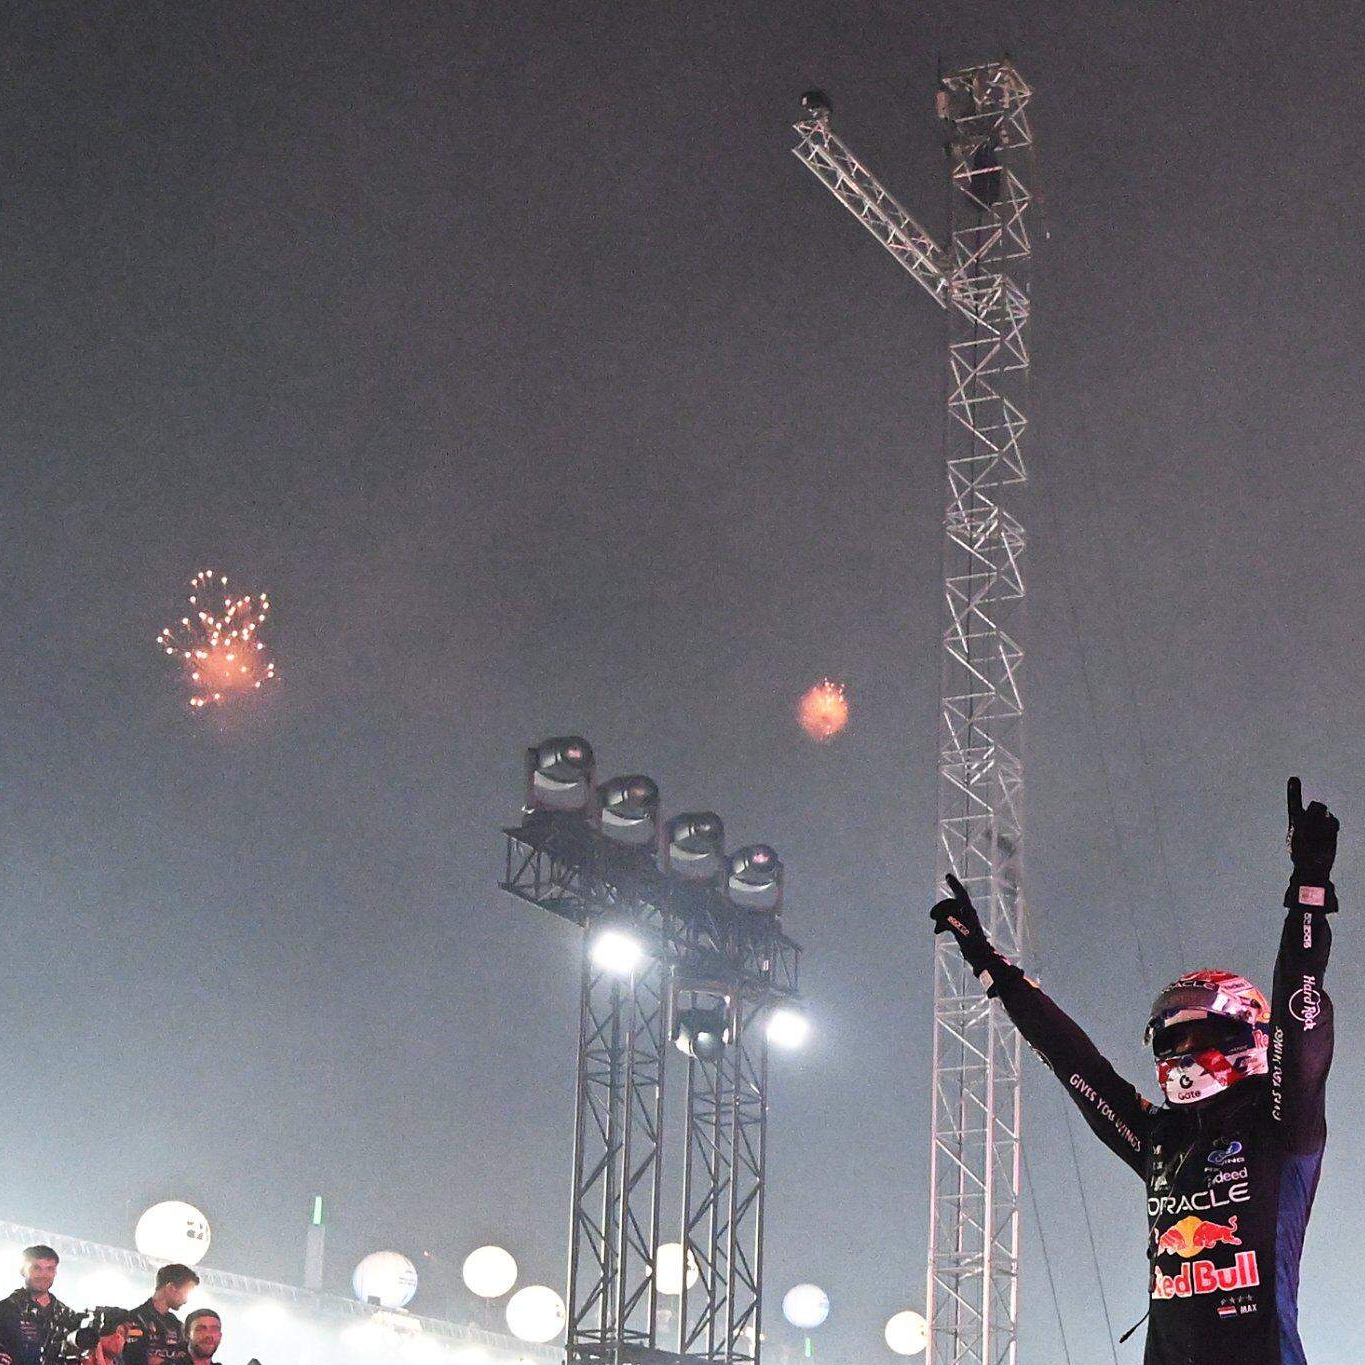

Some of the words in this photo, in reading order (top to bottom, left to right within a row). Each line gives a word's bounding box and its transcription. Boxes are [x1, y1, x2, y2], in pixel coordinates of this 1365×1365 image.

[1070, 1072, 1098, 1102] GIVES
[1096, 1098, 1115, 1122] YOU
[1147, 1182, 1251, 1216] ORACLE
[1193, 1251, 1260, 1294] Bull
[1240, 1303, 1257, 1314] MAX
